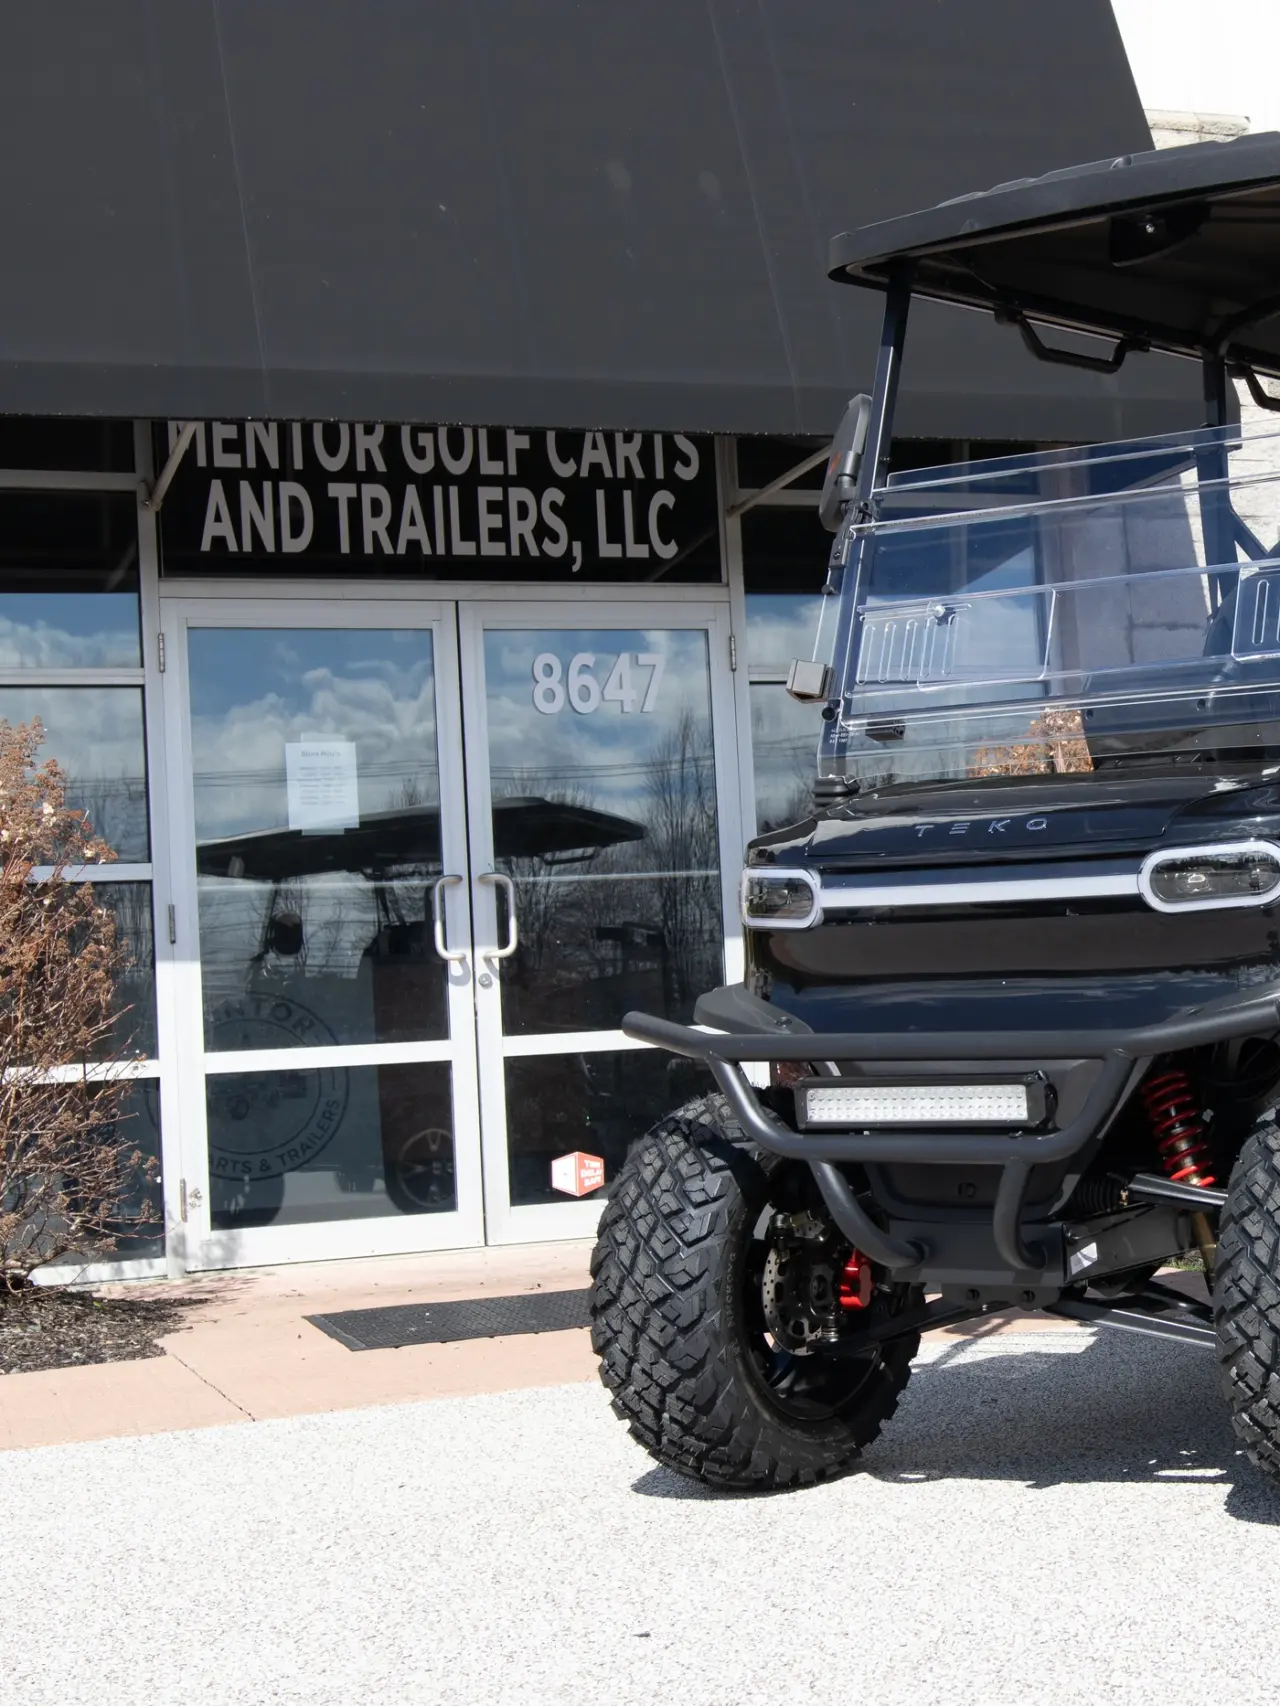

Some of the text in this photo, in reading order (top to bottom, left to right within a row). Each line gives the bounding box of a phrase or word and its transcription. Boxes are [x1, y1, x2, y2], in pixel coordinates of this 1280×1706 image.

[400, 424, 530, 475] GOLF
[200, 479, 679, 573] AND TRAILERS, LLC
[531, 652, 666, 716] 8647
[914, 817, 1048, 837] TEKO
[275, 1099, 340, 1167] TRAILERS
